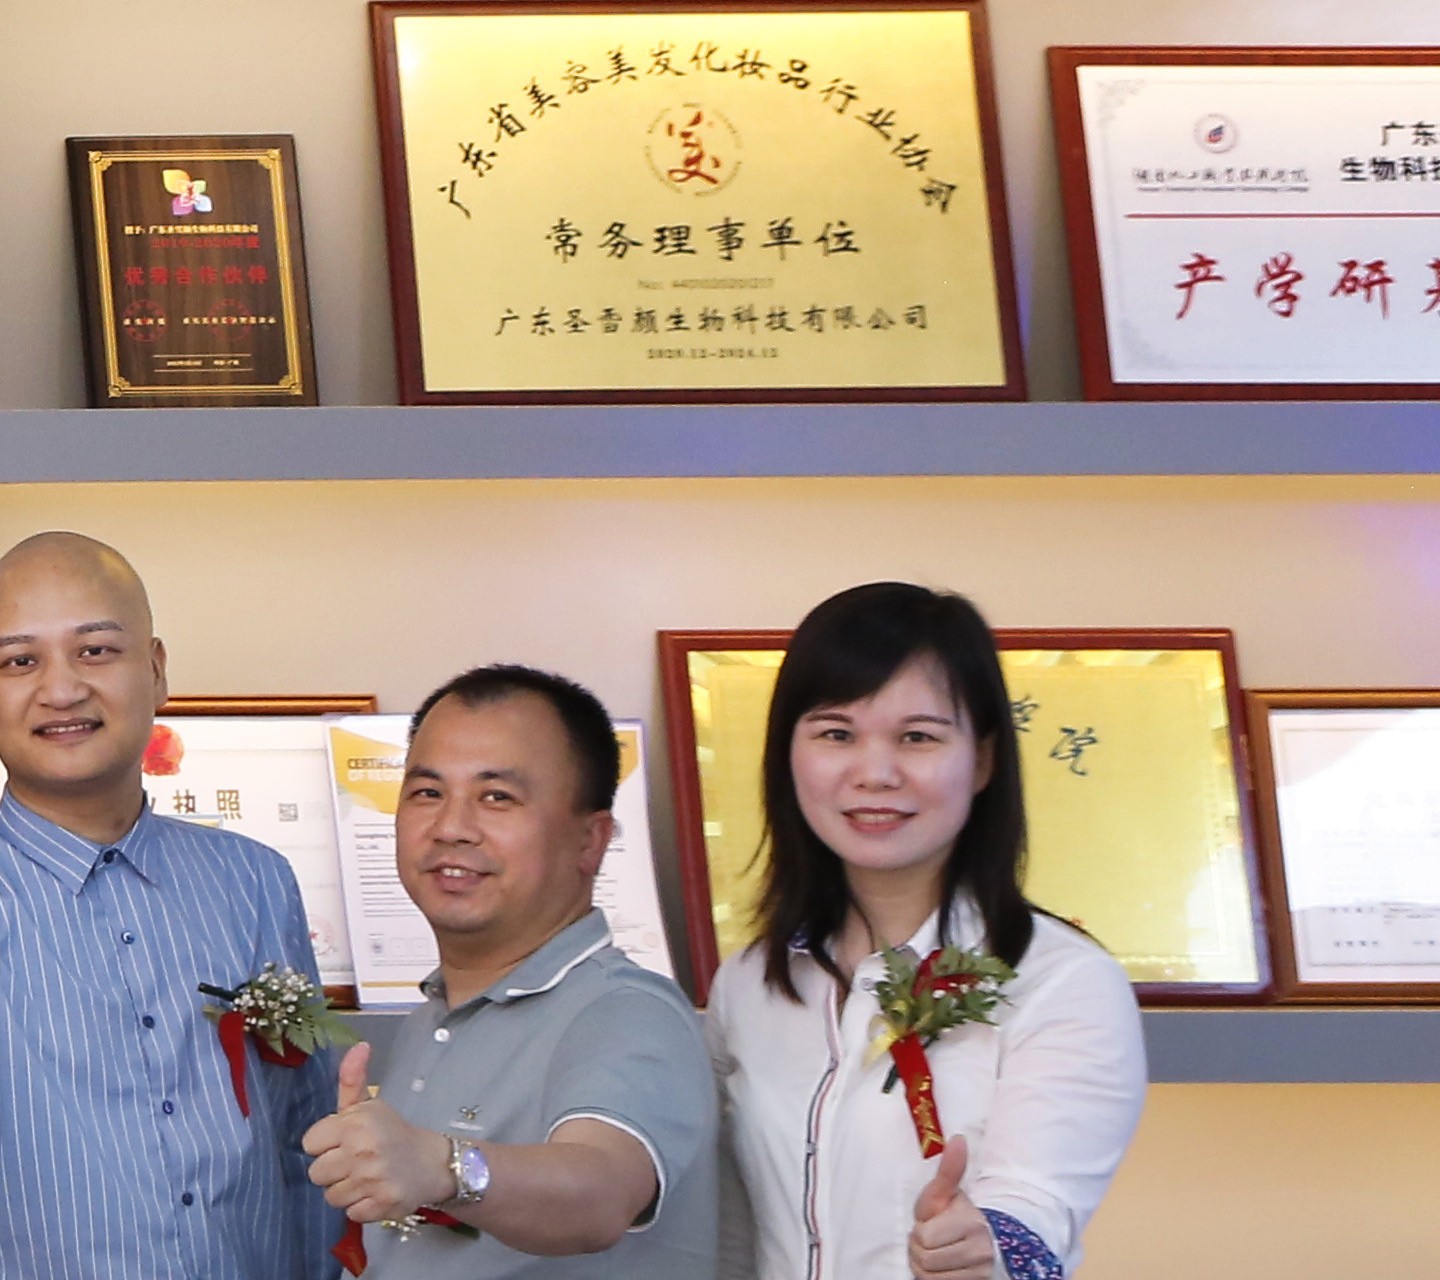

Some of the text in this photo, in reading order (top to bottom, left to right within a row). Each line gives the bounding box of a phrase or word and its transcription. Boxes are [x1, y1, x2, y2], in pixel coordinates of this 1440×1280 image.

[544, 216, 863, 263] 常务理事单位
